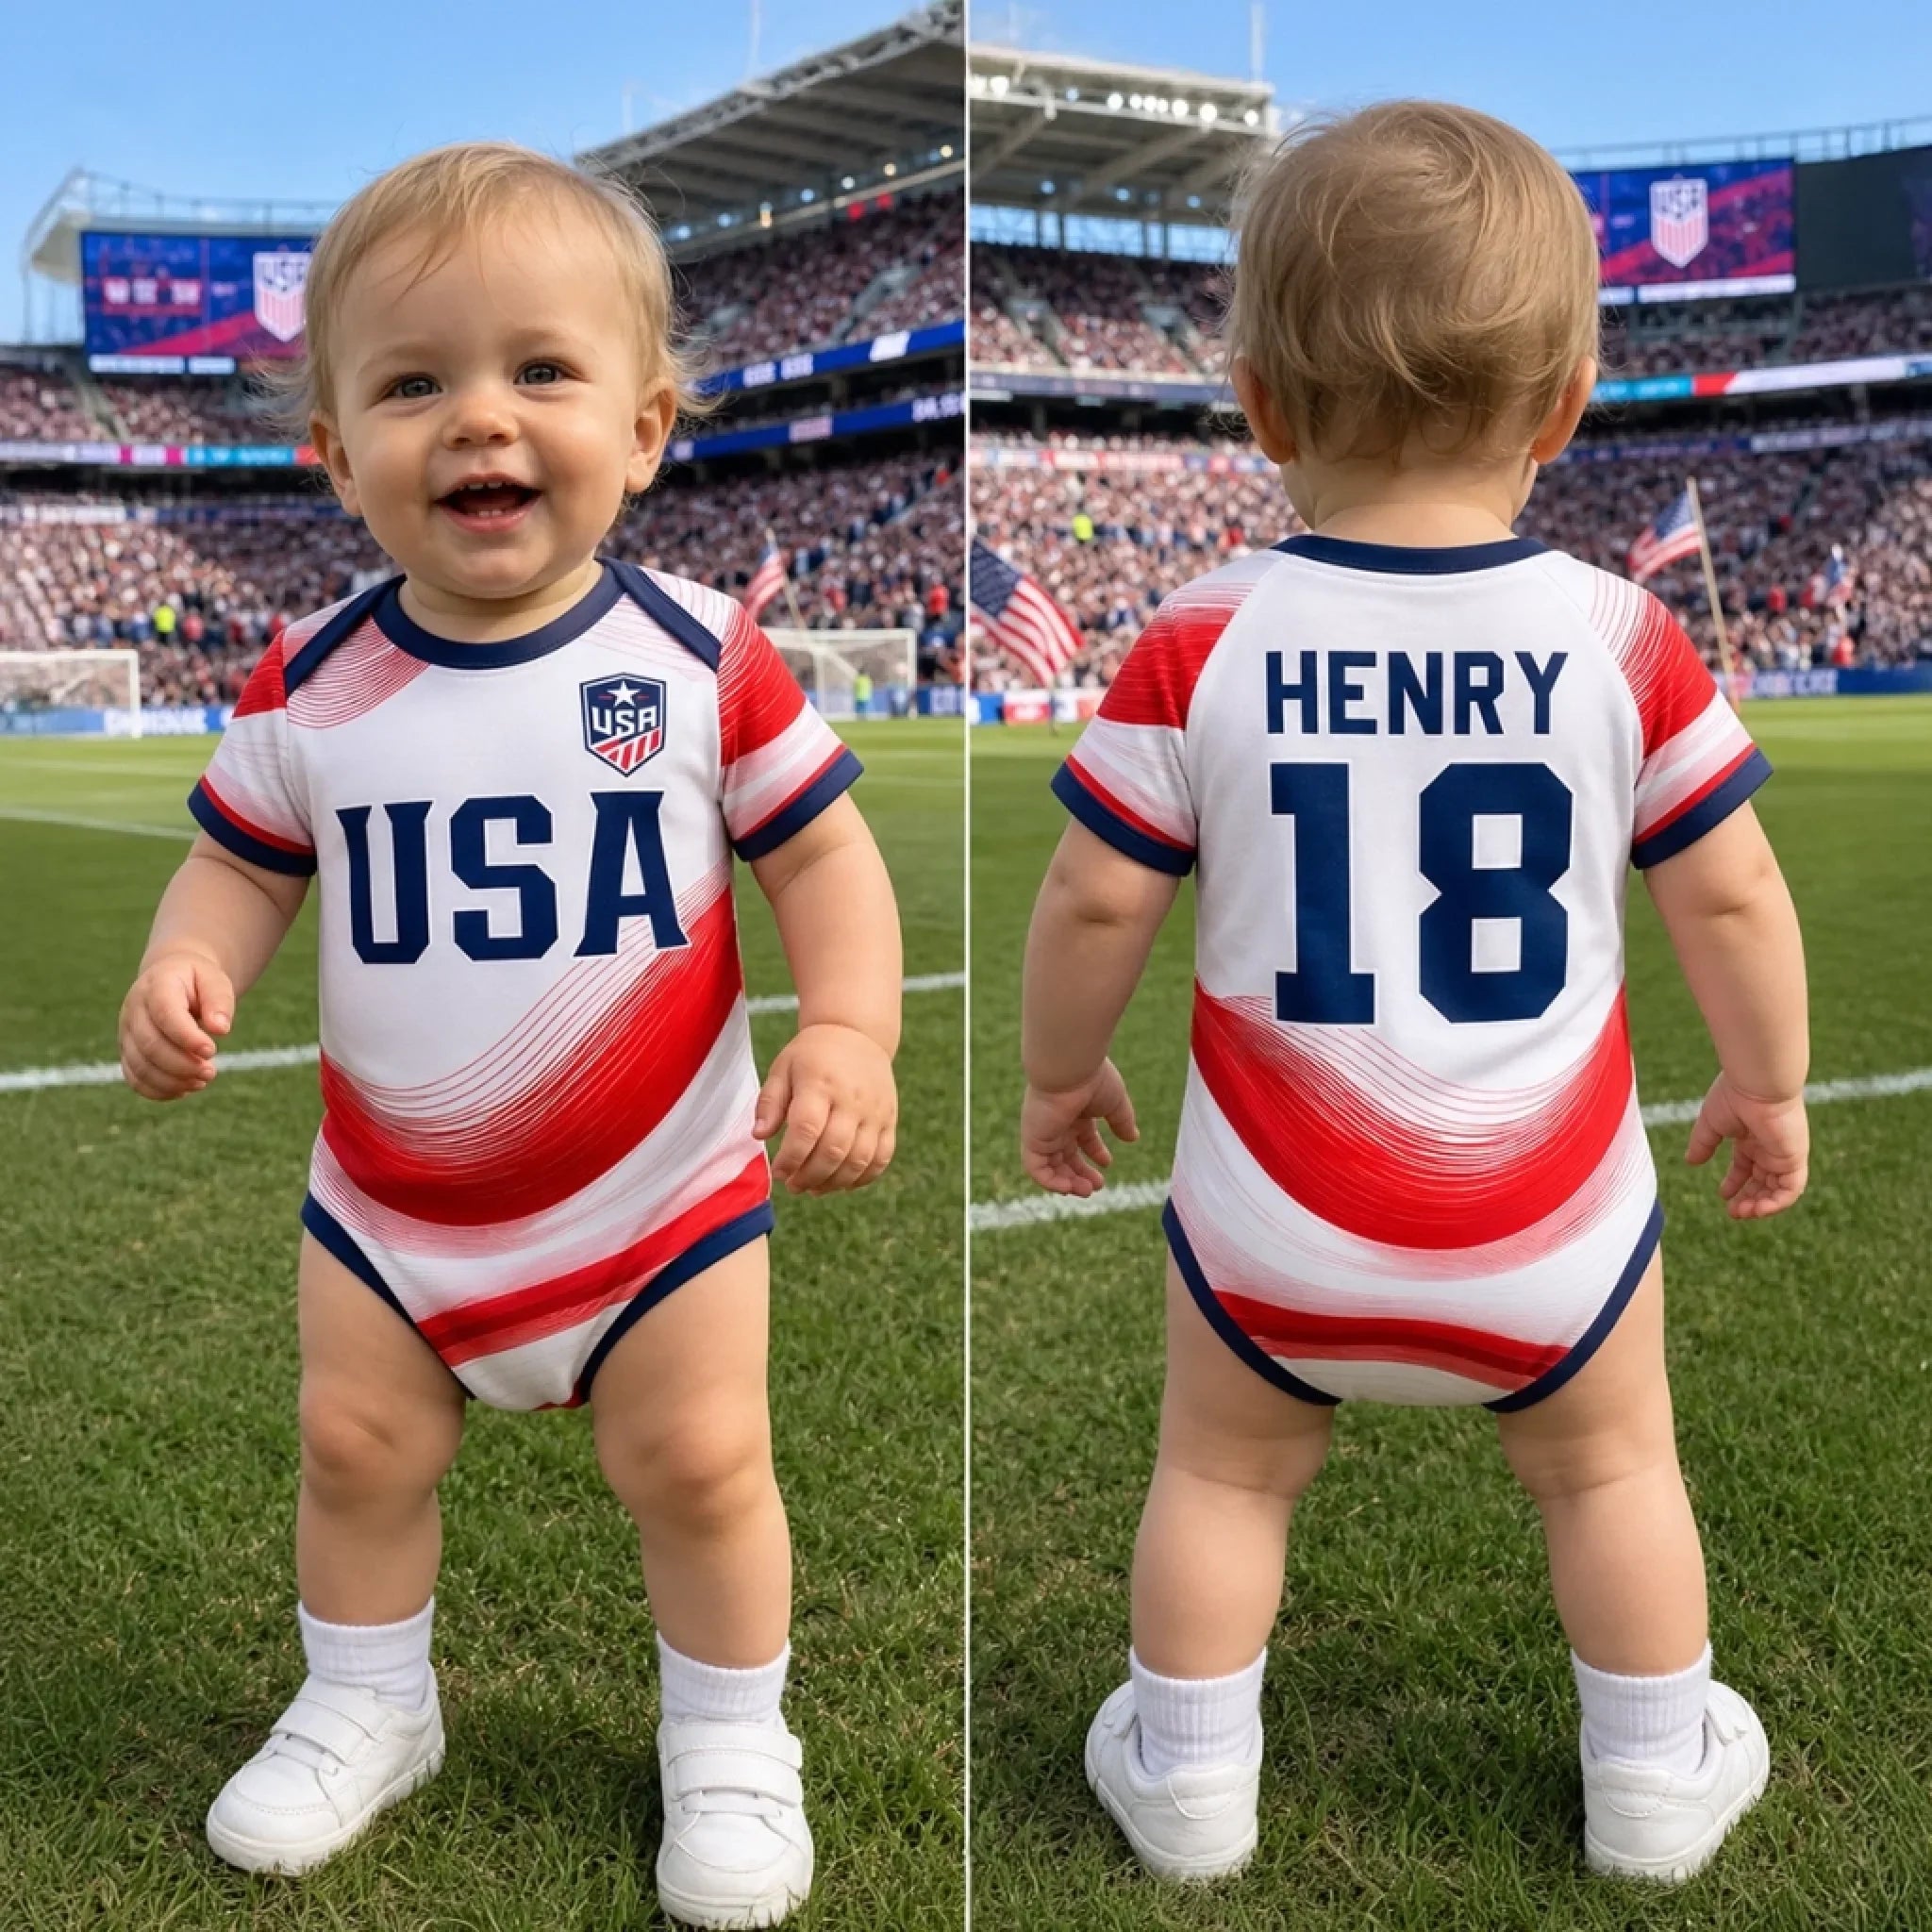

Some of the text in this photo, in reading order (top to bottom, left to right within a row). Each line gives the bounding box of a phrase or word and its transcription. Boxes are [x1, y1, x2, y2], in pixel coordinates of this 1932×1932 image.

[591, 705, 658, 737] USA
[1265, 650, 1569, 735] HENRY
[335, 790, 691, 965] USA
[1270, 760, 1574, 1024] 18
